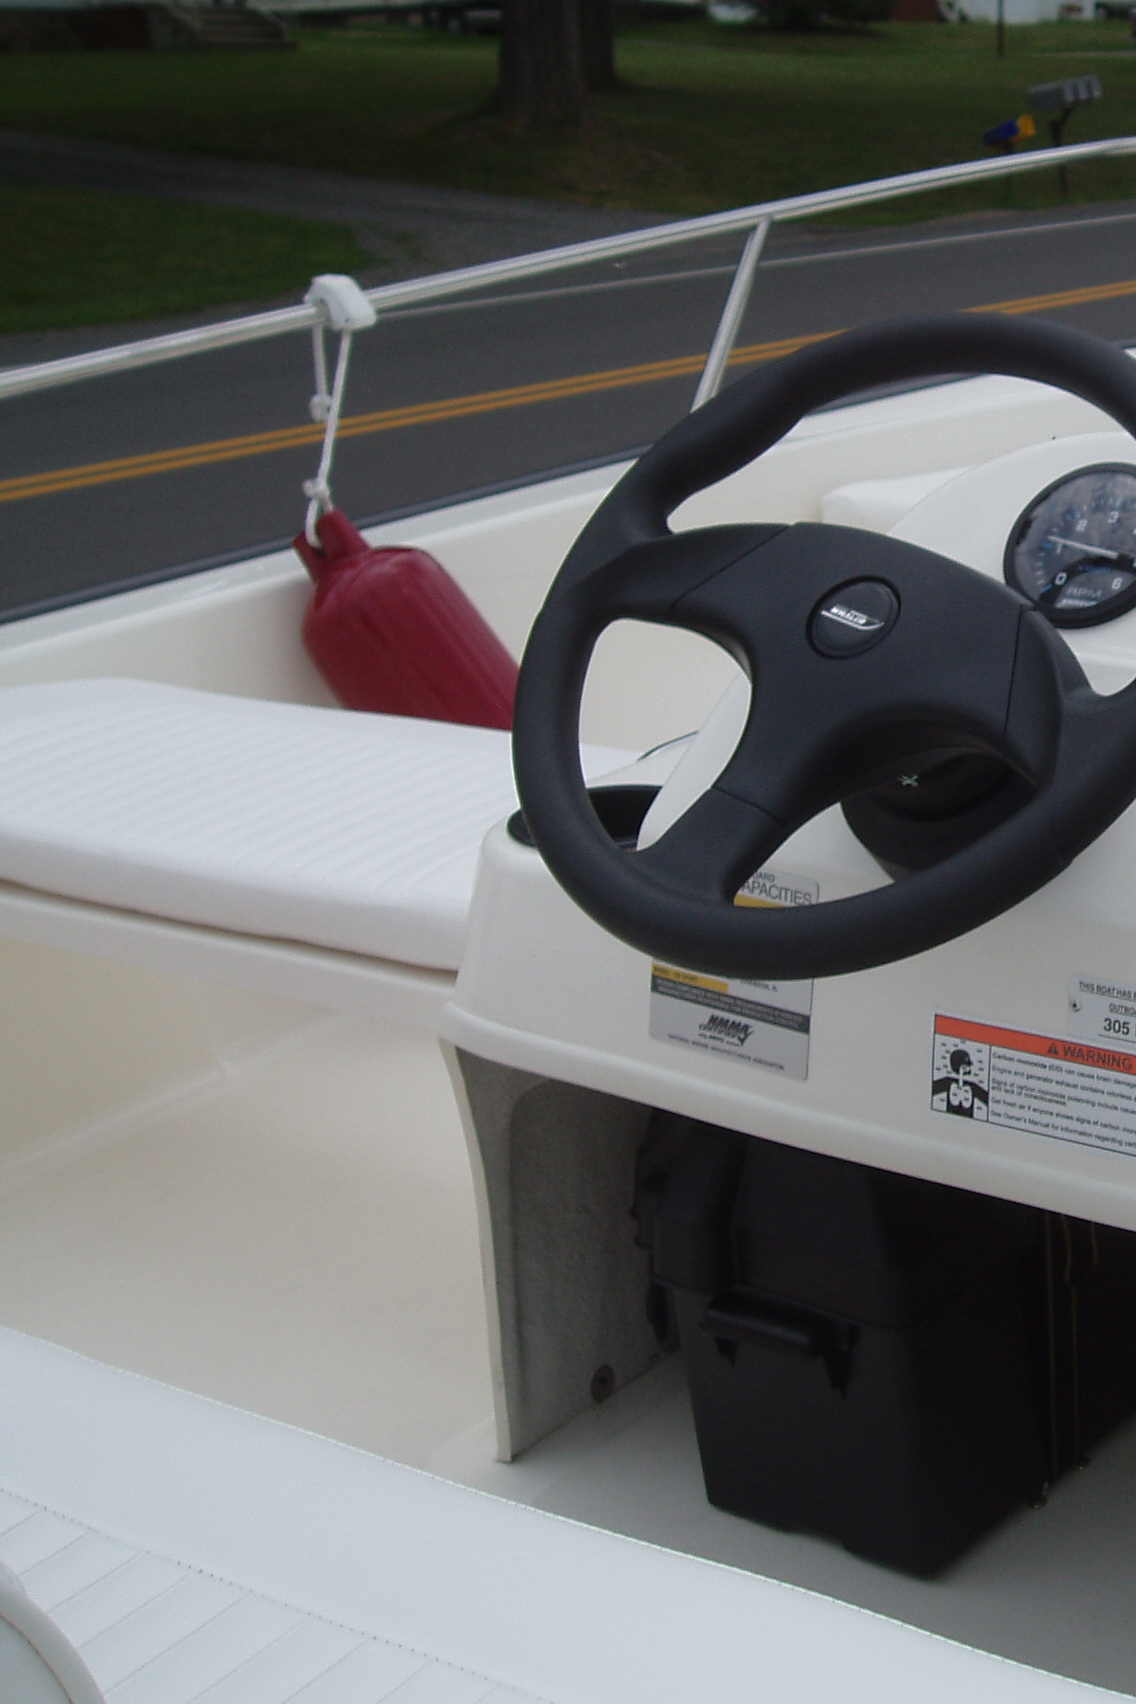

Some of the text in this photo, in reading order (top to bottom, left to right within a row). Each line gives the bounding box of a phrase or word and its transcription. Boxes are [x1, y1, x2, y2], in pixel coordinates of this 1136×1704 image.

[742, 880, 813, 905] APACITIES
[1079, 982, 1094, 991] THIS
[1096, 985, 1114, 995] BOAT
[1114, 988, 1132, 999] HAS
[1103, 1017, 1130, 1036] 305
[1063, 1043, 1132, 1071] WARNING
